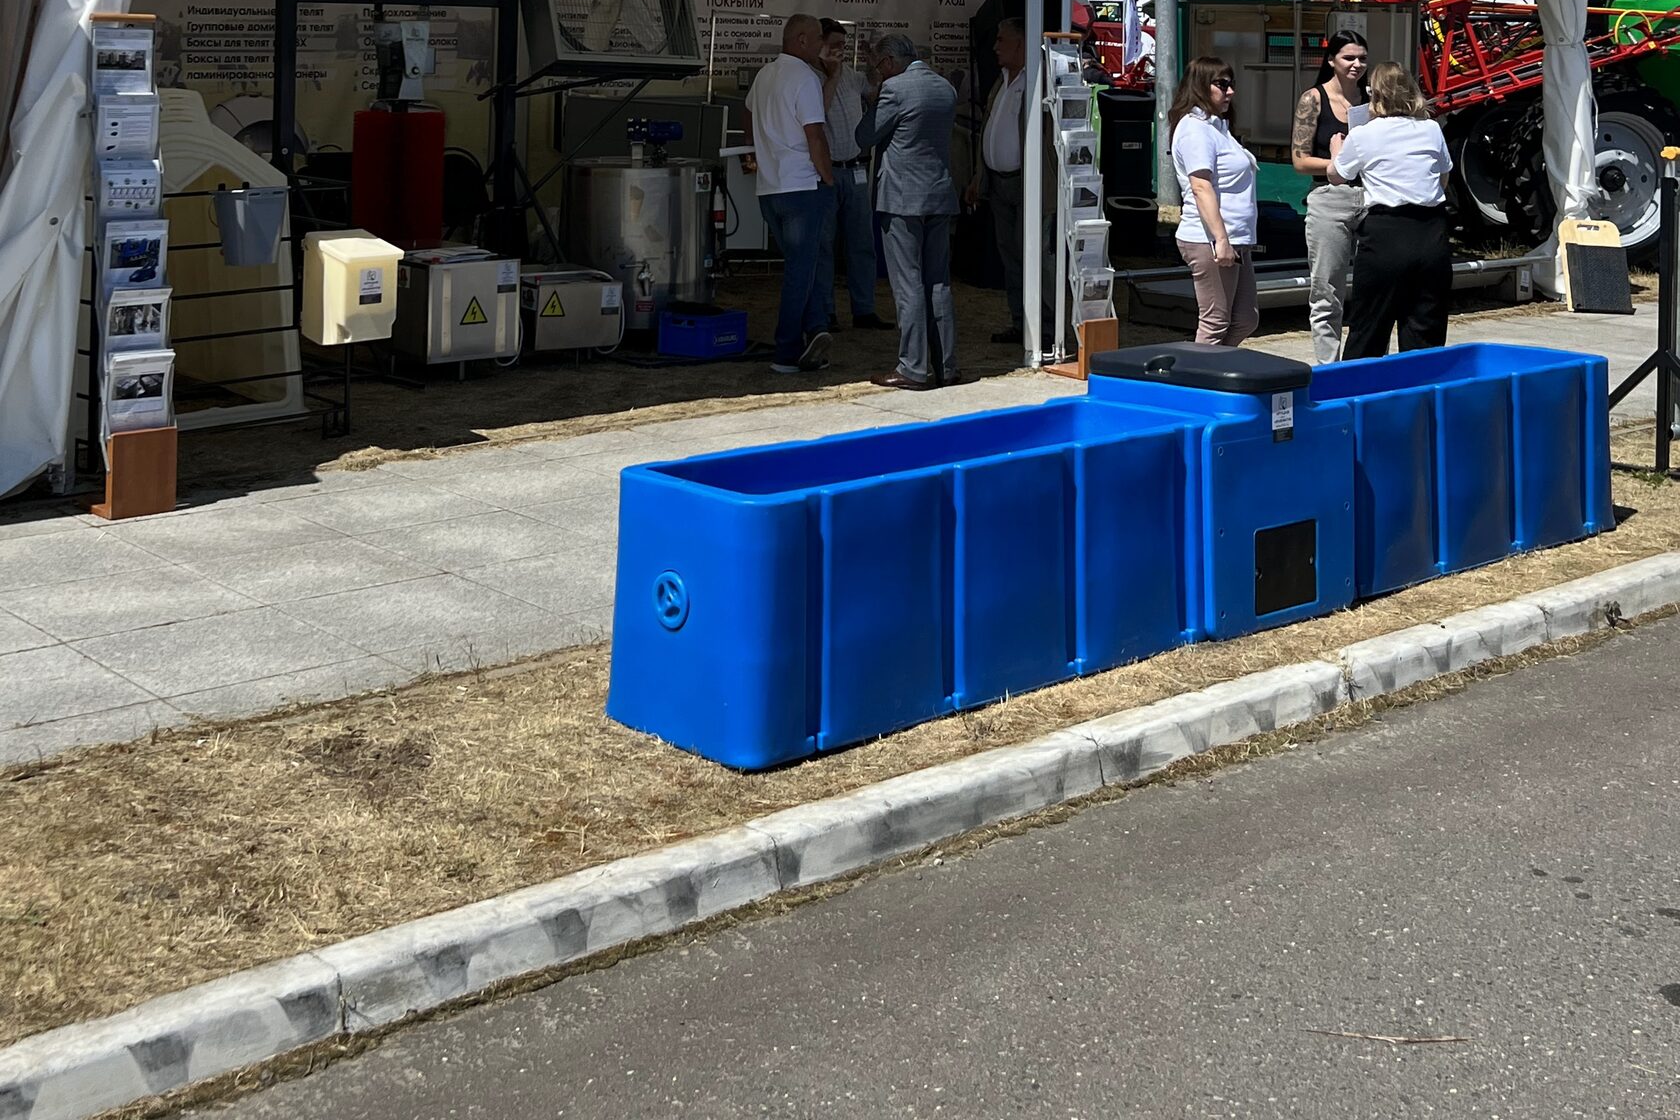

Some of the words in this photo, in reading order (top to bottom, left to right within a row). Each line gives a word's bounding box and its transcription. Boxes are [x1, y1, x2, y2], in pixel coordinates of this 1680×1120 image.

[299, 8, 324, 16] телят
[187, 22, 244, 32] Групповые
[309, 24, 334, 32] телят
[731, 30, 761, 38] основой
[187, 38, 221, 47] Боксы
[224, 40, 241, 48] для
[244, 39, 270, 47] телят
[428, 39, 458, 47] олока
[735, 42, 750, 50] ППУ
[187, 54, 221, 63] Боксы
[224, 55, 241, 64] для
[244, 55, 270, 63] телят
[186, 71, 276, 81] ламинированно
[295, 71, 327, 81] анеры
